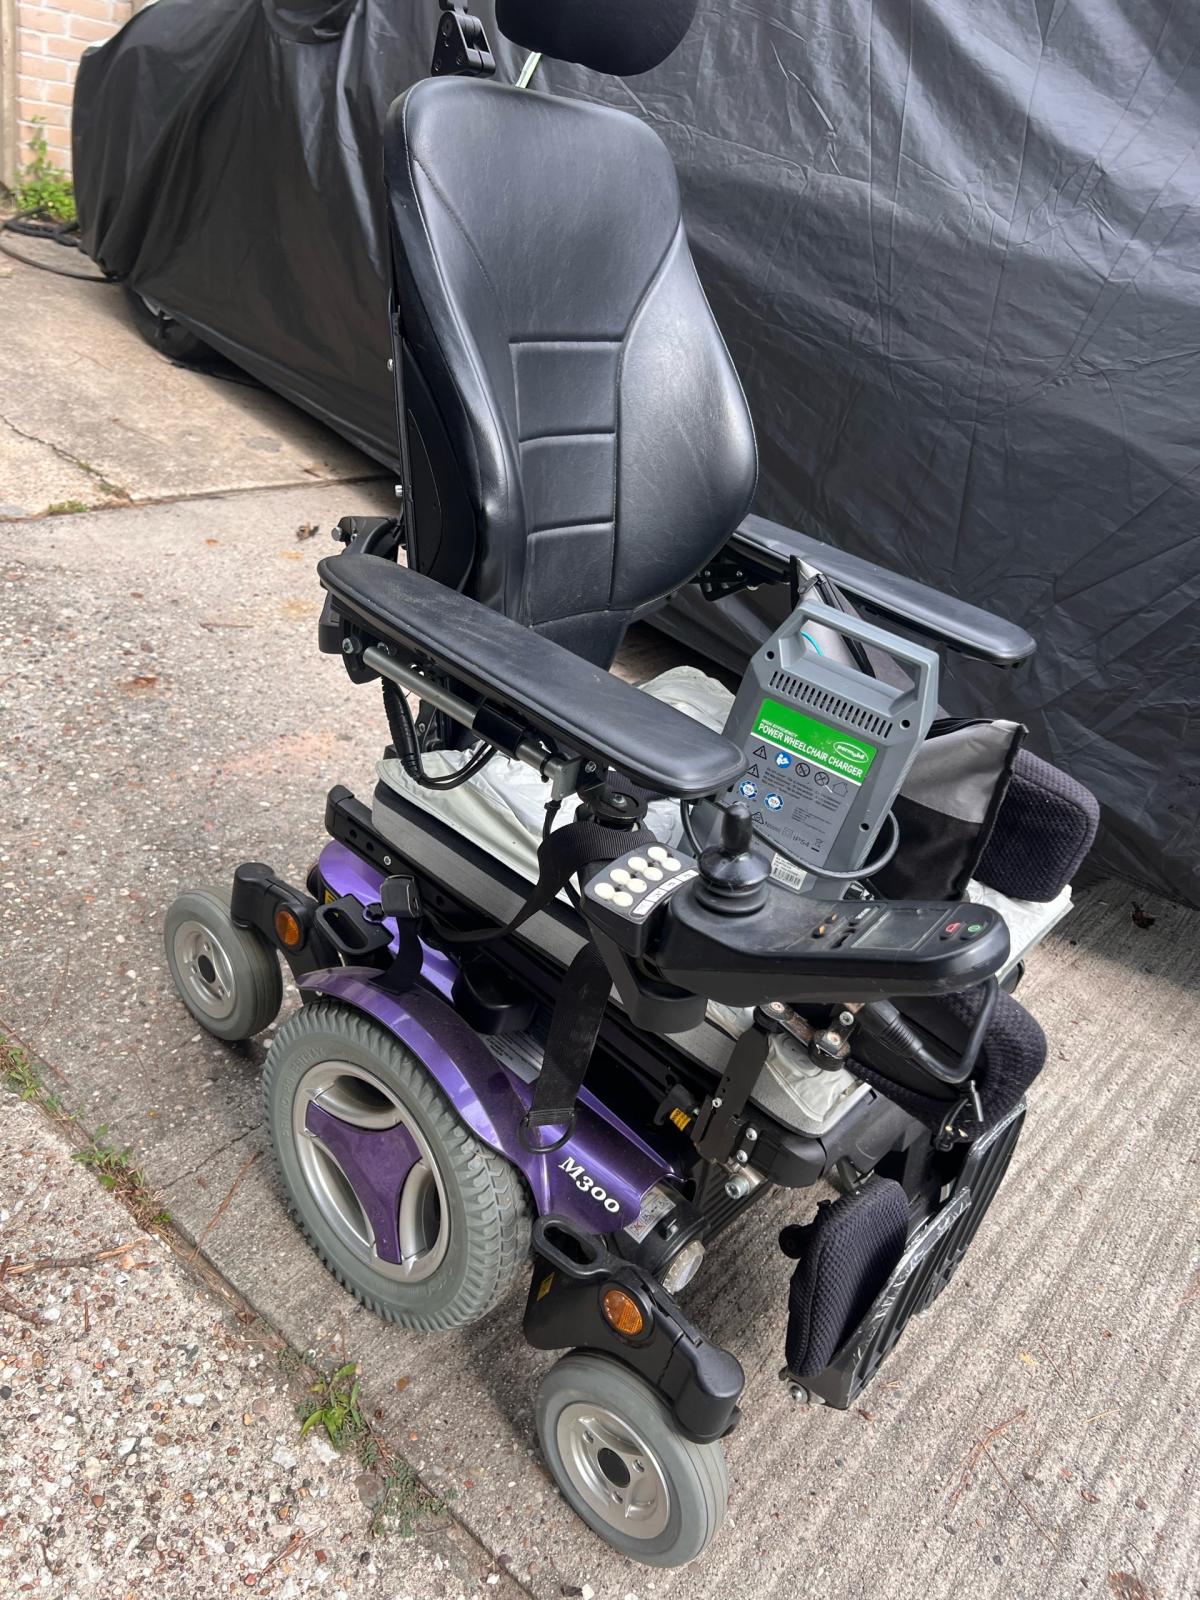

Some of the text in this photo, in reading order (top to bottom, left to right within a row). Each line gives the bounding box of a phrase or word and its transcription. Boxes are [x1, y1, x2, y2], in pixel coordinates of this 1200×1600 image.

[758, 722, 863, 778] POWER WHEELCHAIR CHARGER
[558, 1157, 620, 1213] M300
